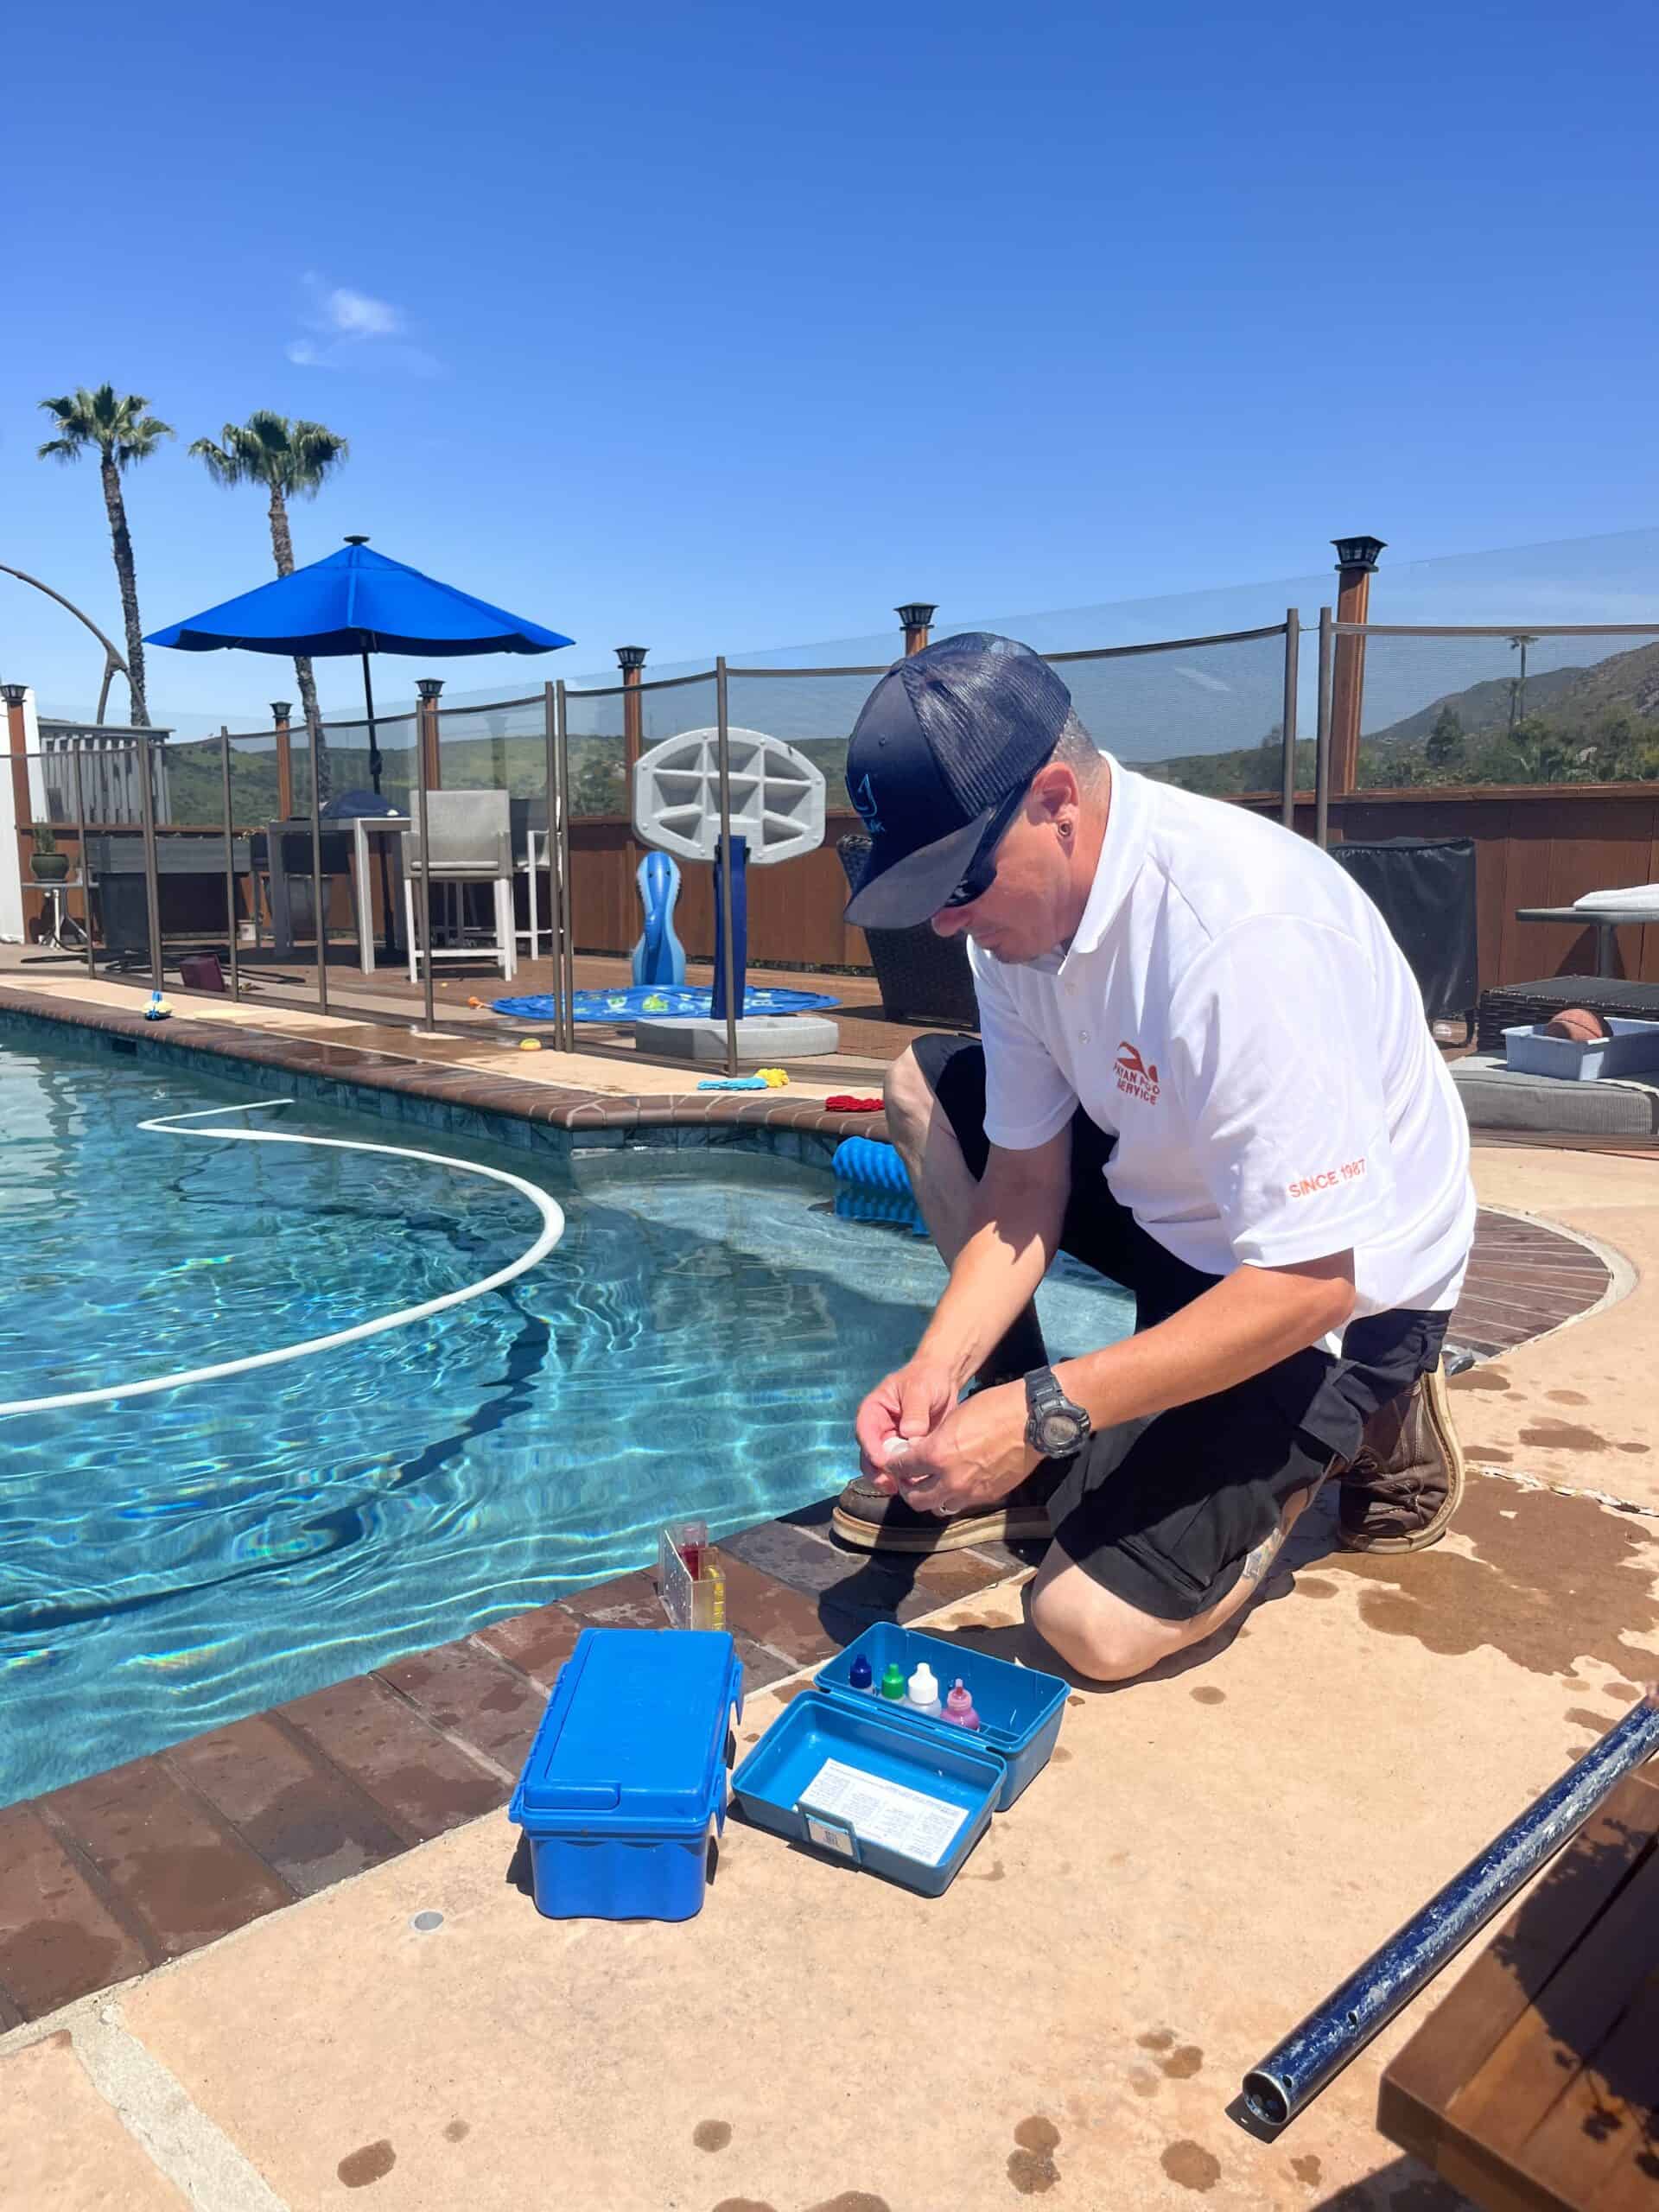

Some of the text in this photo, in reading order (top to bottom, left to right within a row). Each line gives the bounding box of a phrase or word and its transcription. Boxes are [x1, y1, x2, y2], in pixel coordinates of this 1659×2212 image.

[1117, 1077, 1157, 1105] SERVICE
[1288, 1158, 1365, 1198] SINCE 1987
